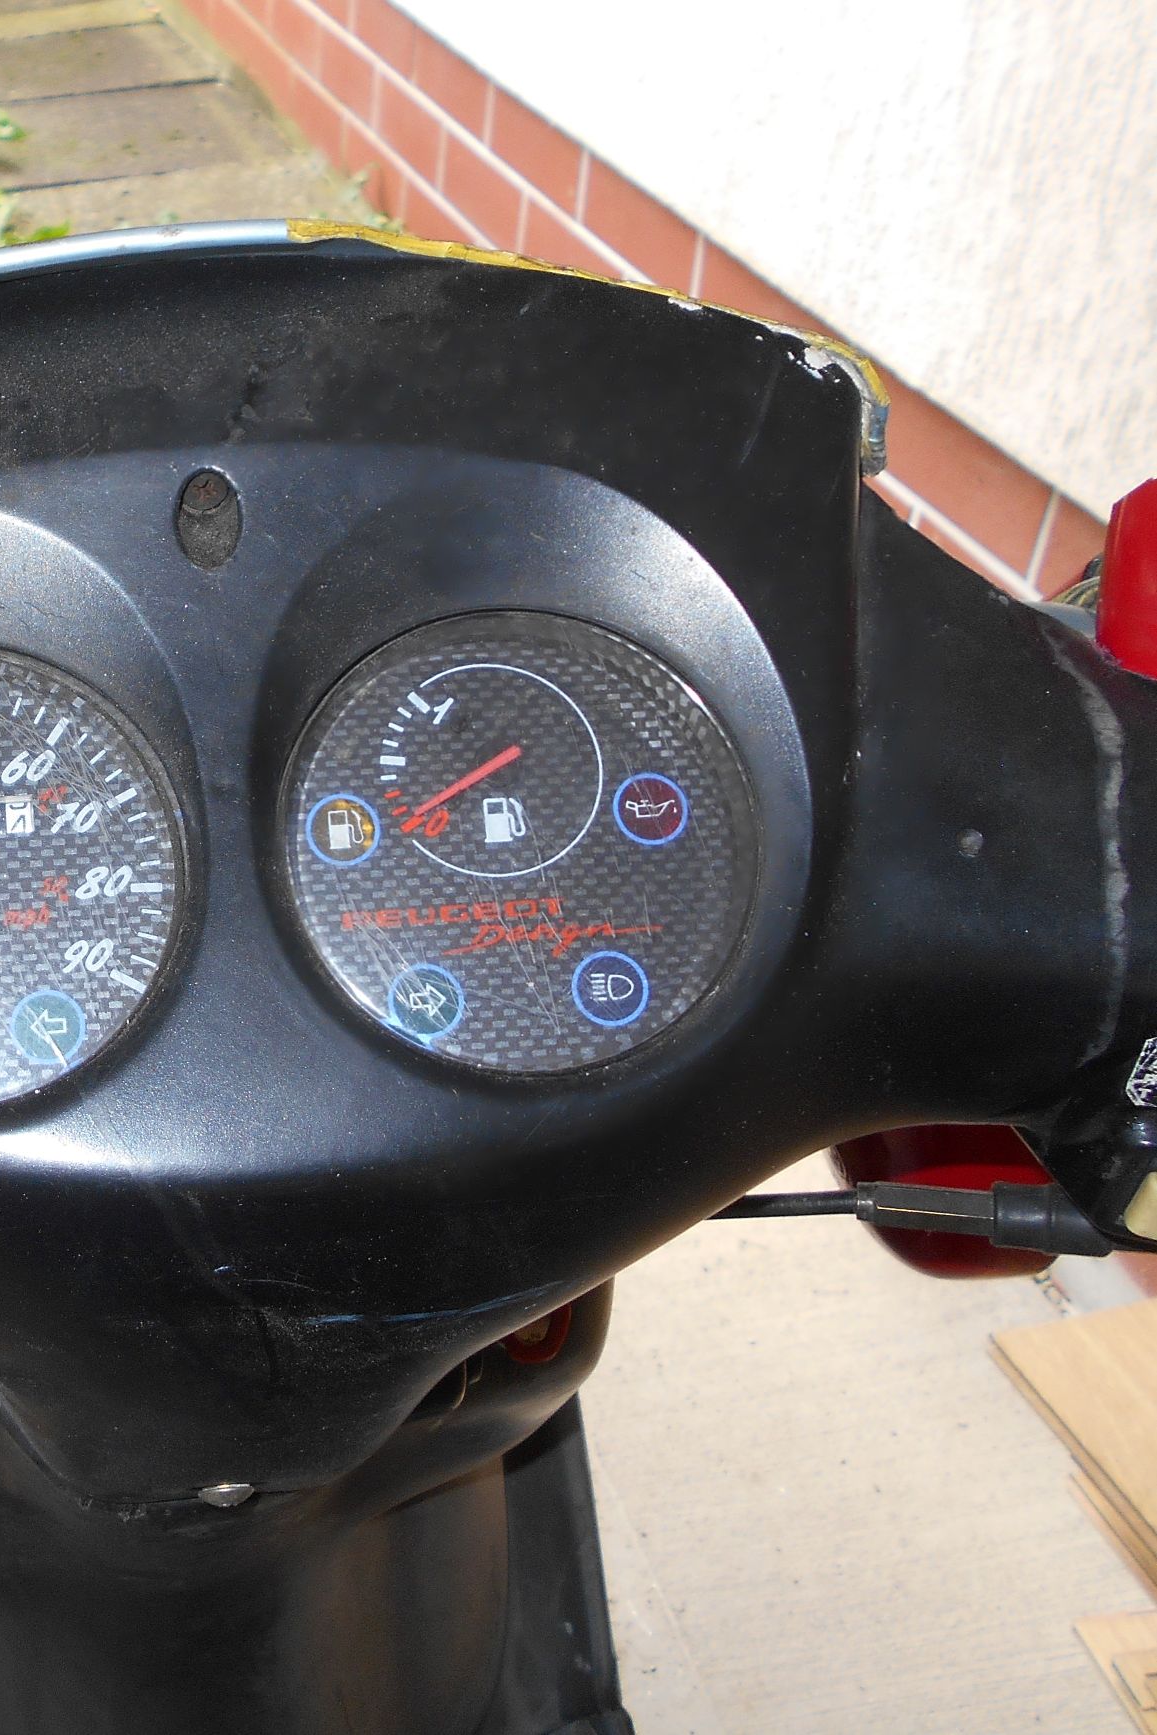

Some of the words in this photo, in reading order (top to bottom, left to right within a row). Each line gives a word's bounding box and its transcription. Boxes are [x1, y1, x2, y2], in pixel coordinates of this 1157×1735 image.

[1, 749, 56, 784] 60
[51, 800, 103, 834] 70
[425, 808, 450, 838] 0
[75, 865, 134, 900] 80
[341, 896, 565, 931] PEUGEOT
[444, 917, 664, 959] Design
[62, 938, 115, 975] 90
